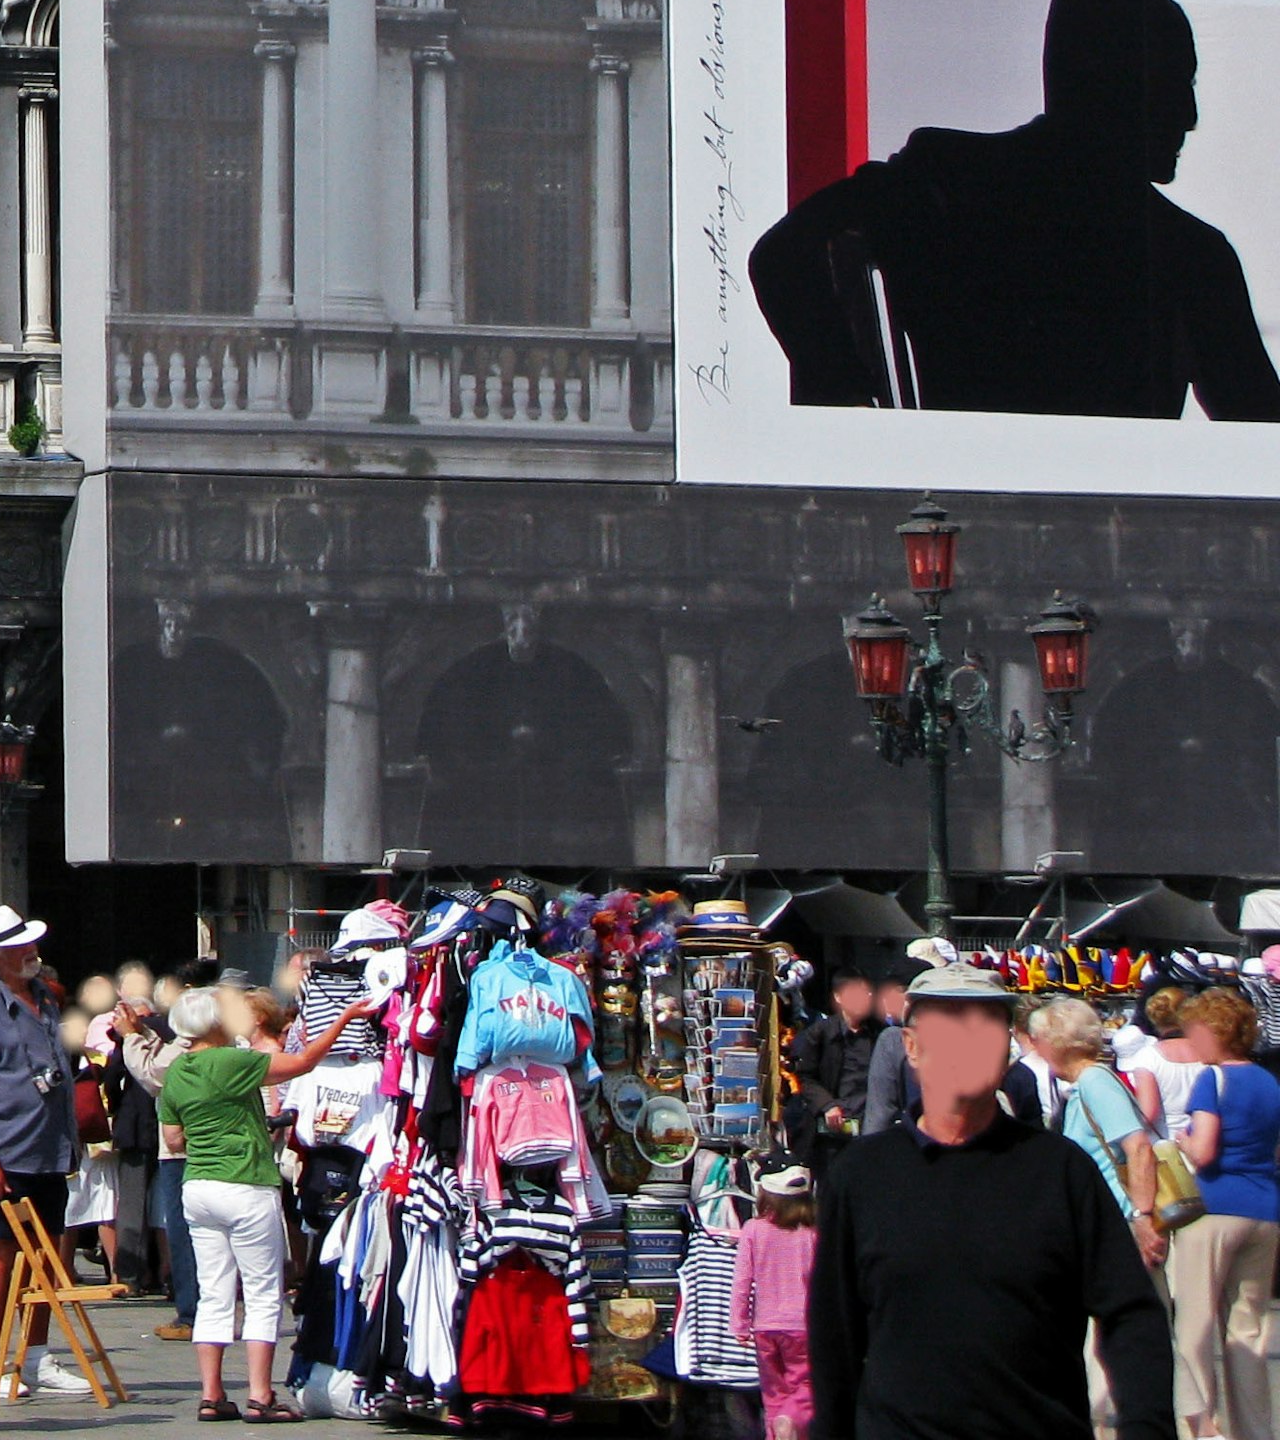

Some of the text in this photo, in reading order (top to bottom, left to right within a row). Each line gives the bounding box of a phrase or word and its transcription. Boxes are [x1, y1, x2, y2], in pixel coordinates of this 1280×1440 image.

[704, 108, 733, 162] but
[703, 162, 744, 323] anything
[688, 341, 730, 405] Be
[498, 994, 565, 1021] ITALIA
